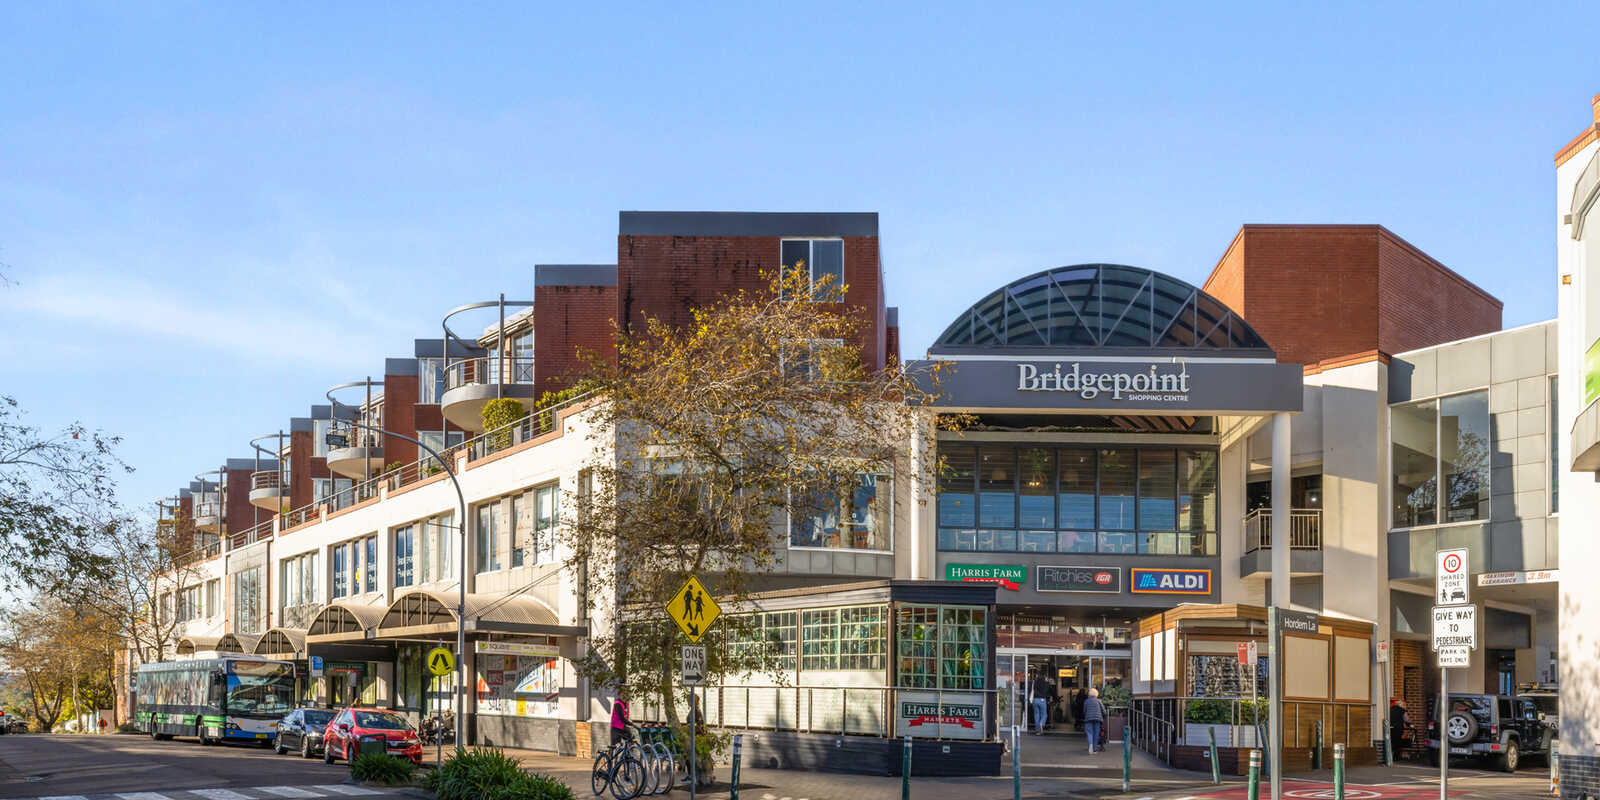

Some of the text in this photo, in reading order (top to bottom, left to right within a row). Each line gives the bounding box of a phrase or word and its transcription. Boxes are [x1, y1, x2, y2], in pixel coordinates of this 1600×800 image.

[1017, 363, 1190, 399] Bridgepoint
[1163, 394, 1189, 402] CENTRE
[1448, 559, 1457, 568] 10
[952, 567, 1021, 578] HARRIS FARM
[1044, 568, 1093, 584] Ritchies
[1440, 573, 1465, 581] SHARED
[1159, 574, 1204, 589] ALDI
[1444, 580, 1460, 588] ZONE
[1435, 610, 1473, 621] GIVE WAY
[1308, 620, 1316, 631] La
[1449, 623, 1459, 632] TO
[1435, 636, 1472, 645] PEDESTRIANS
[684, 648, 704, 659] ONE
[684, 660, 704, 671] WAY
[907, 705, 978, 717] HARRS FARM
